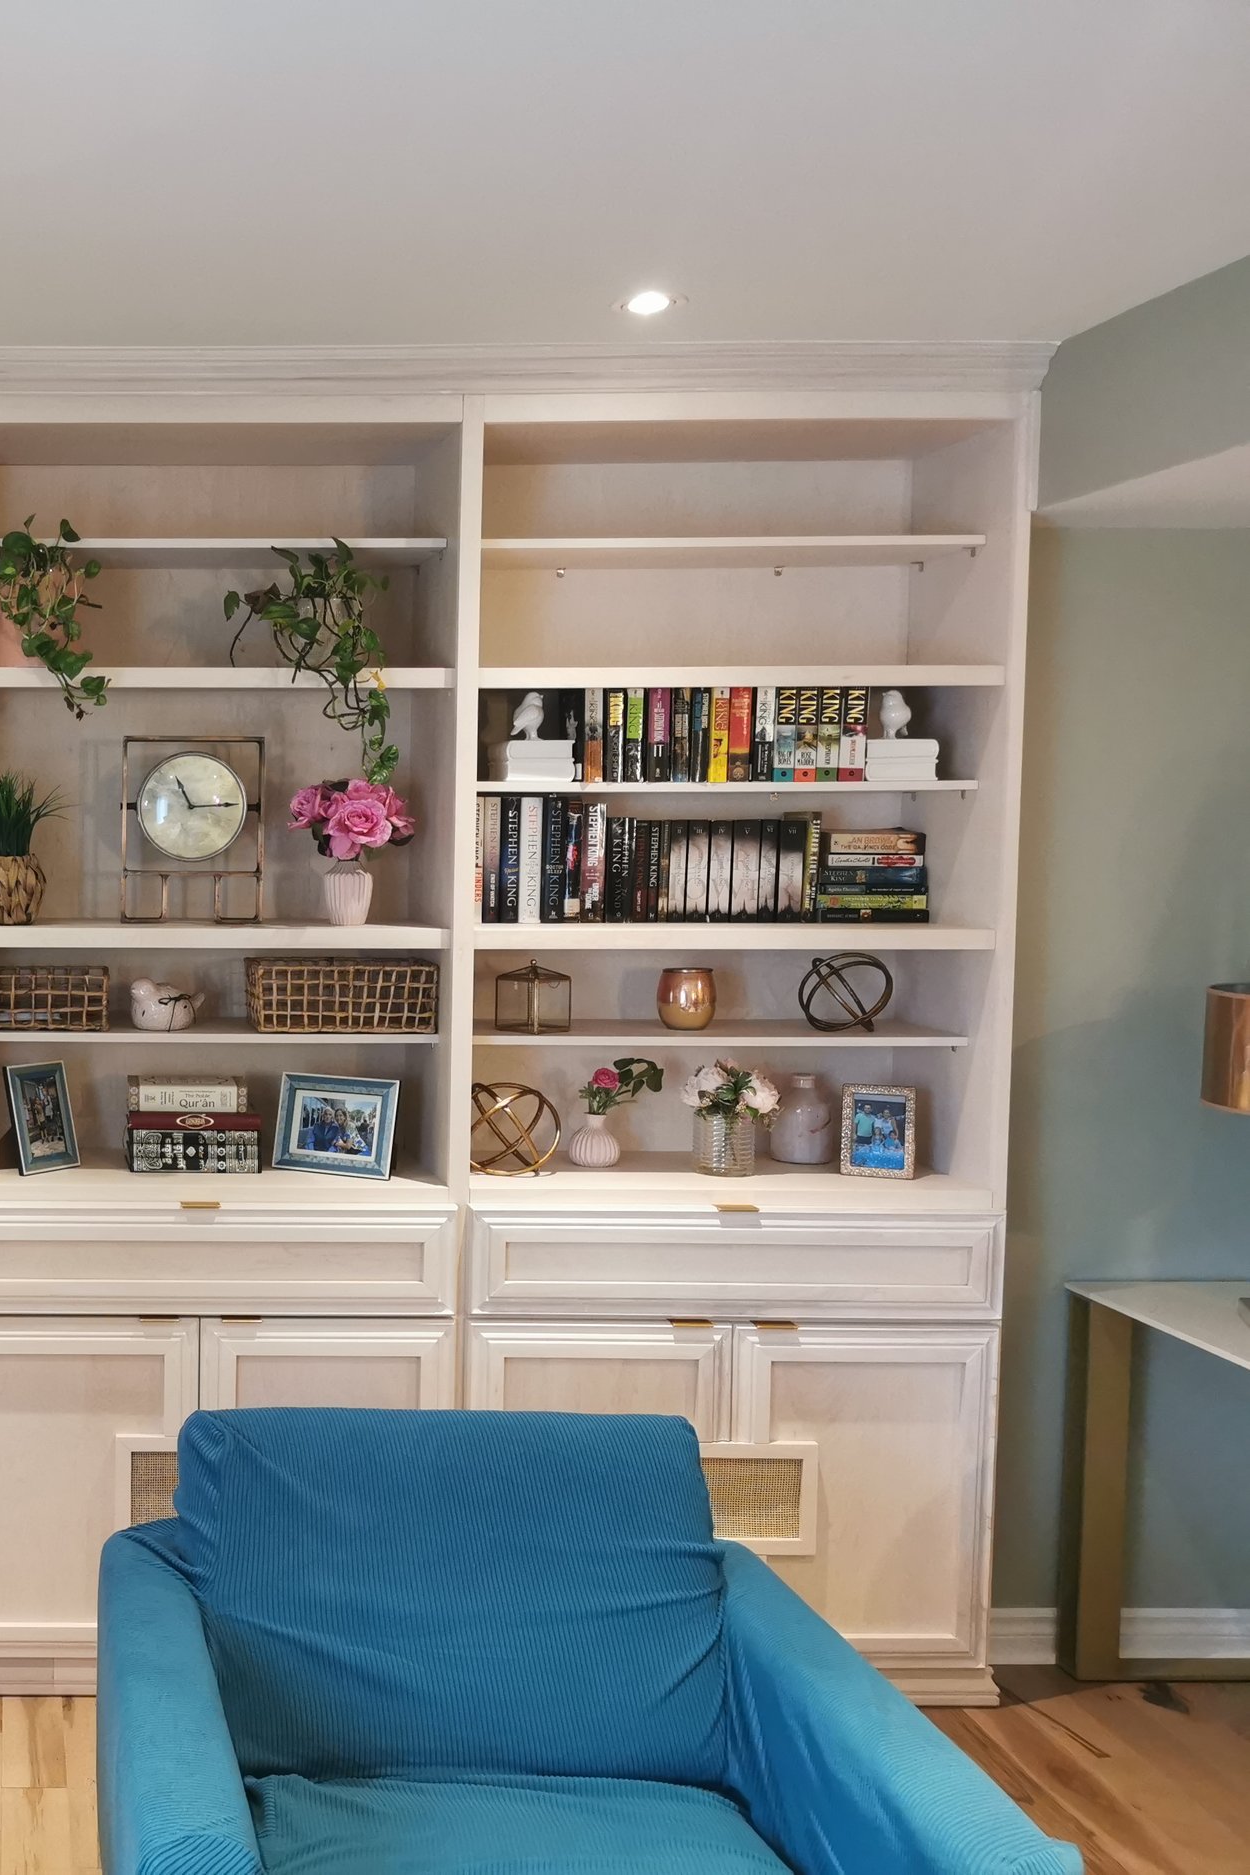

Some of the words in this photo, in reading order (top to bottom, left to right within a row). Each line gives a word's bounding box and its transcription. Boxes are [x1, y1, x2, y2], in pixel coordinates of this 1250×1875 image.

[610, 698, 623, 726] KING
[629, 703, 638, 733] KING
[701, 693, 709, 715] STEPHEN
[715, 699, 723, 730] KING
[758, 703, 767, 725] KING
[778, 690, 796, 723] KING
[799, 690, 817, 723] KING
[821, 690, 840, 722] KING
[846, 690, 865, 723] KING
[653, 744, 664, 758] IT
[490, 803, 498, 843] STEPHEN
[508, 810, 518, 864] STEPHEN
[528, 806, 538, 859] STEPHEN
[551, 810, 561, 864] STEPHEN
[588, 805, 599, 846] STEPHEN
[811, 820, 821, 855] STEPHEN
[587, 847, 598, 867] KING
[612, 839, 621, 873] KING
[650, 827, 659, 864] STEPHEN
[649, 865, 658, 887] KING
[809, 856, 817, 874] KING
[507, 876, 517, 906] KING
[527, 876, 537, 907] KING
[549, 876, 559, 905] KING
